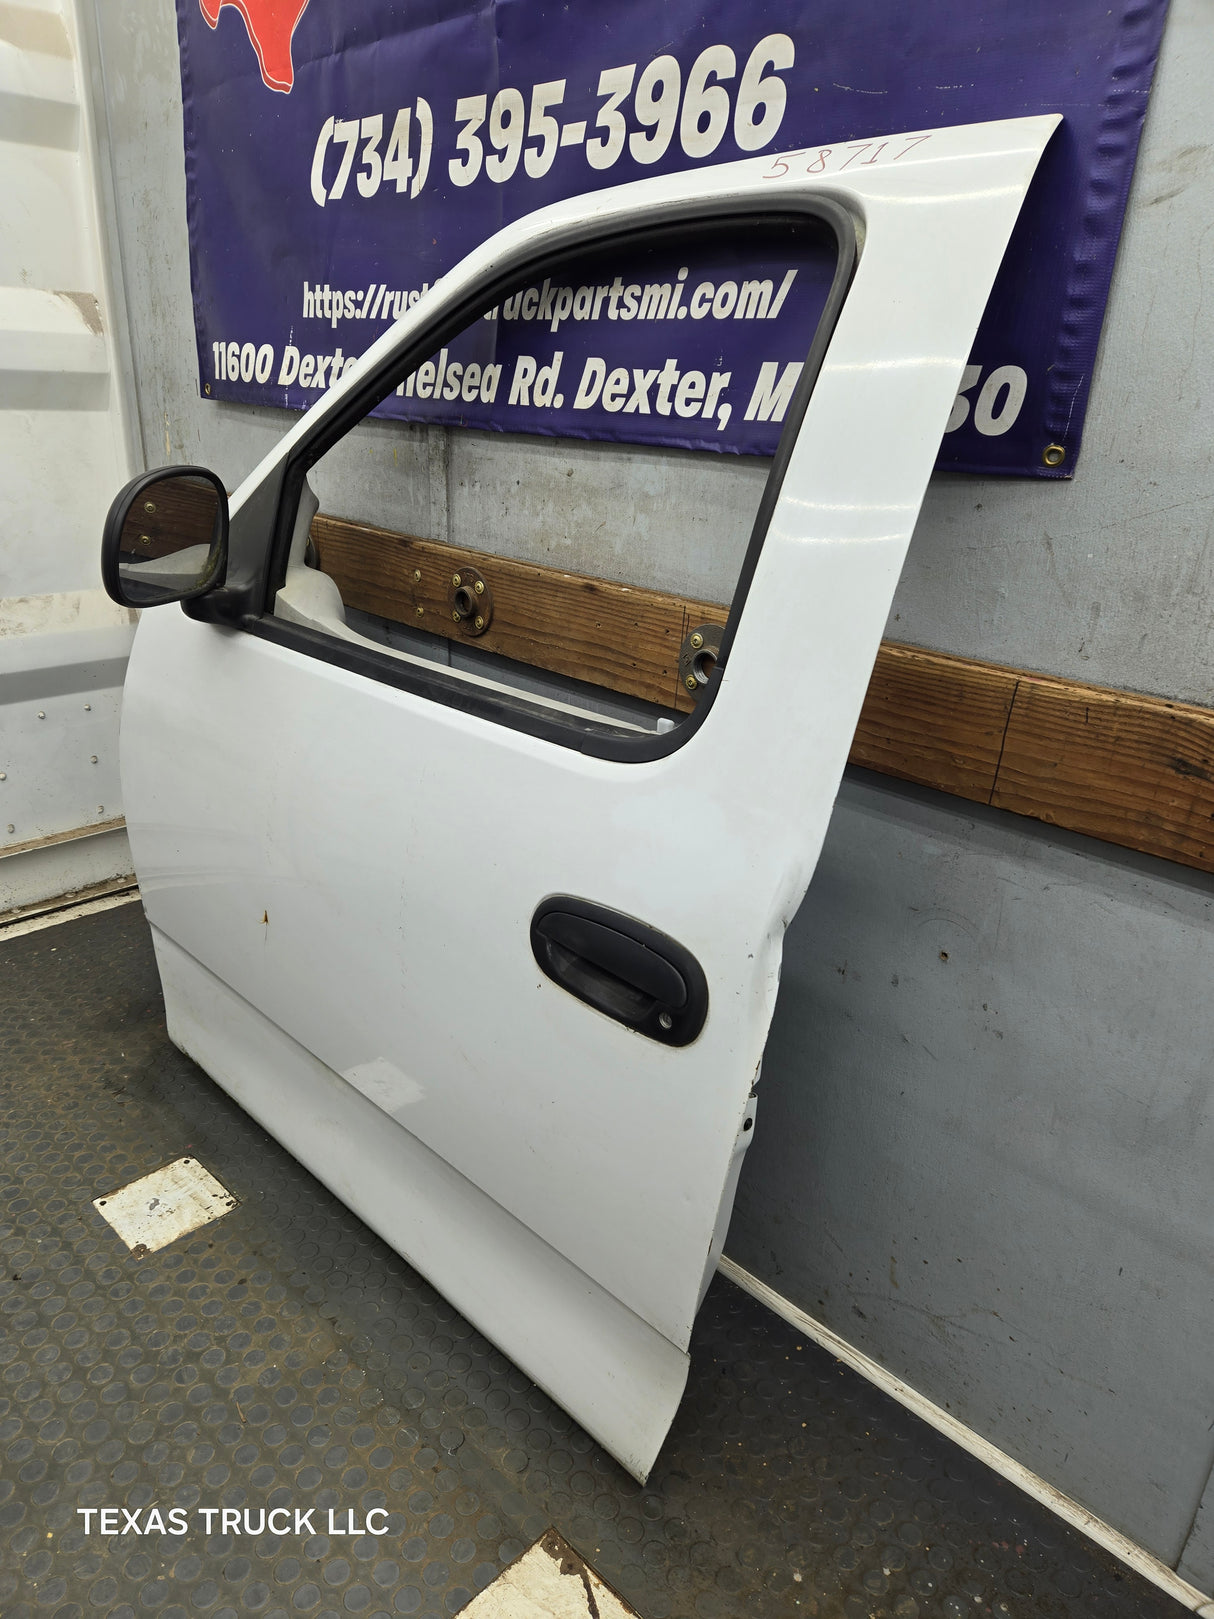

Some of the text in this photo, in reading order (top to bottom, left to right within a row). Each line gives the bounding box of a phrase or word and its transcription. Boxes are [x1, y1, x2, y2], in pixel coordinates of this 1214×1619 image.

[310, 33, 795, 207] (734) 395-3966
[212, 342, 274, 382] 11600
[278, 347, 358, 389] Dext
[396, 348, 502, 404] elsea
[508, 352, 564, 409] Rd.
[573, 357, 732, 431] Dexter,
